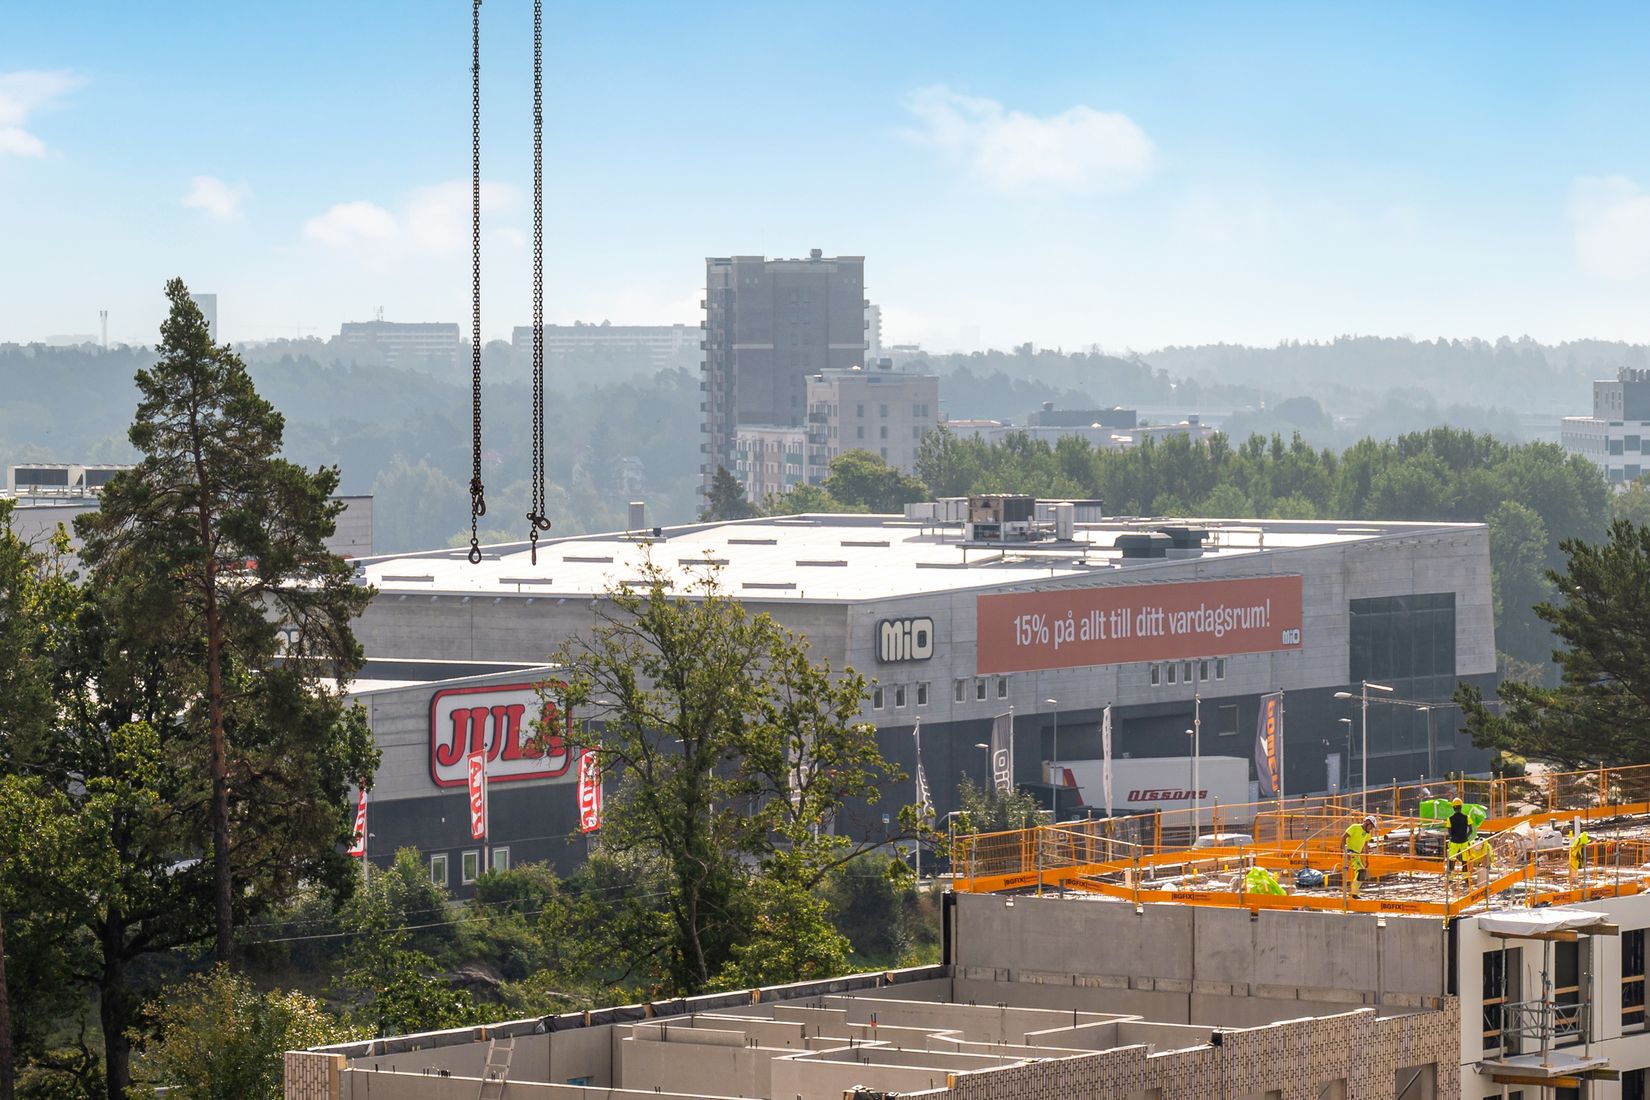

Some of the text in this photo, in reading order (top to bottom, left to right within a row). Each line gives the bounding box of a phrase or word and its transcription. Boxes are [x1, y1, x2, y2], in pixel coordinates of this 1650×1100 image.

[1014, 598, 1271, 650] 15% på allt till ditt vardagsrum!
[437, 701, 567, 767] JULA
